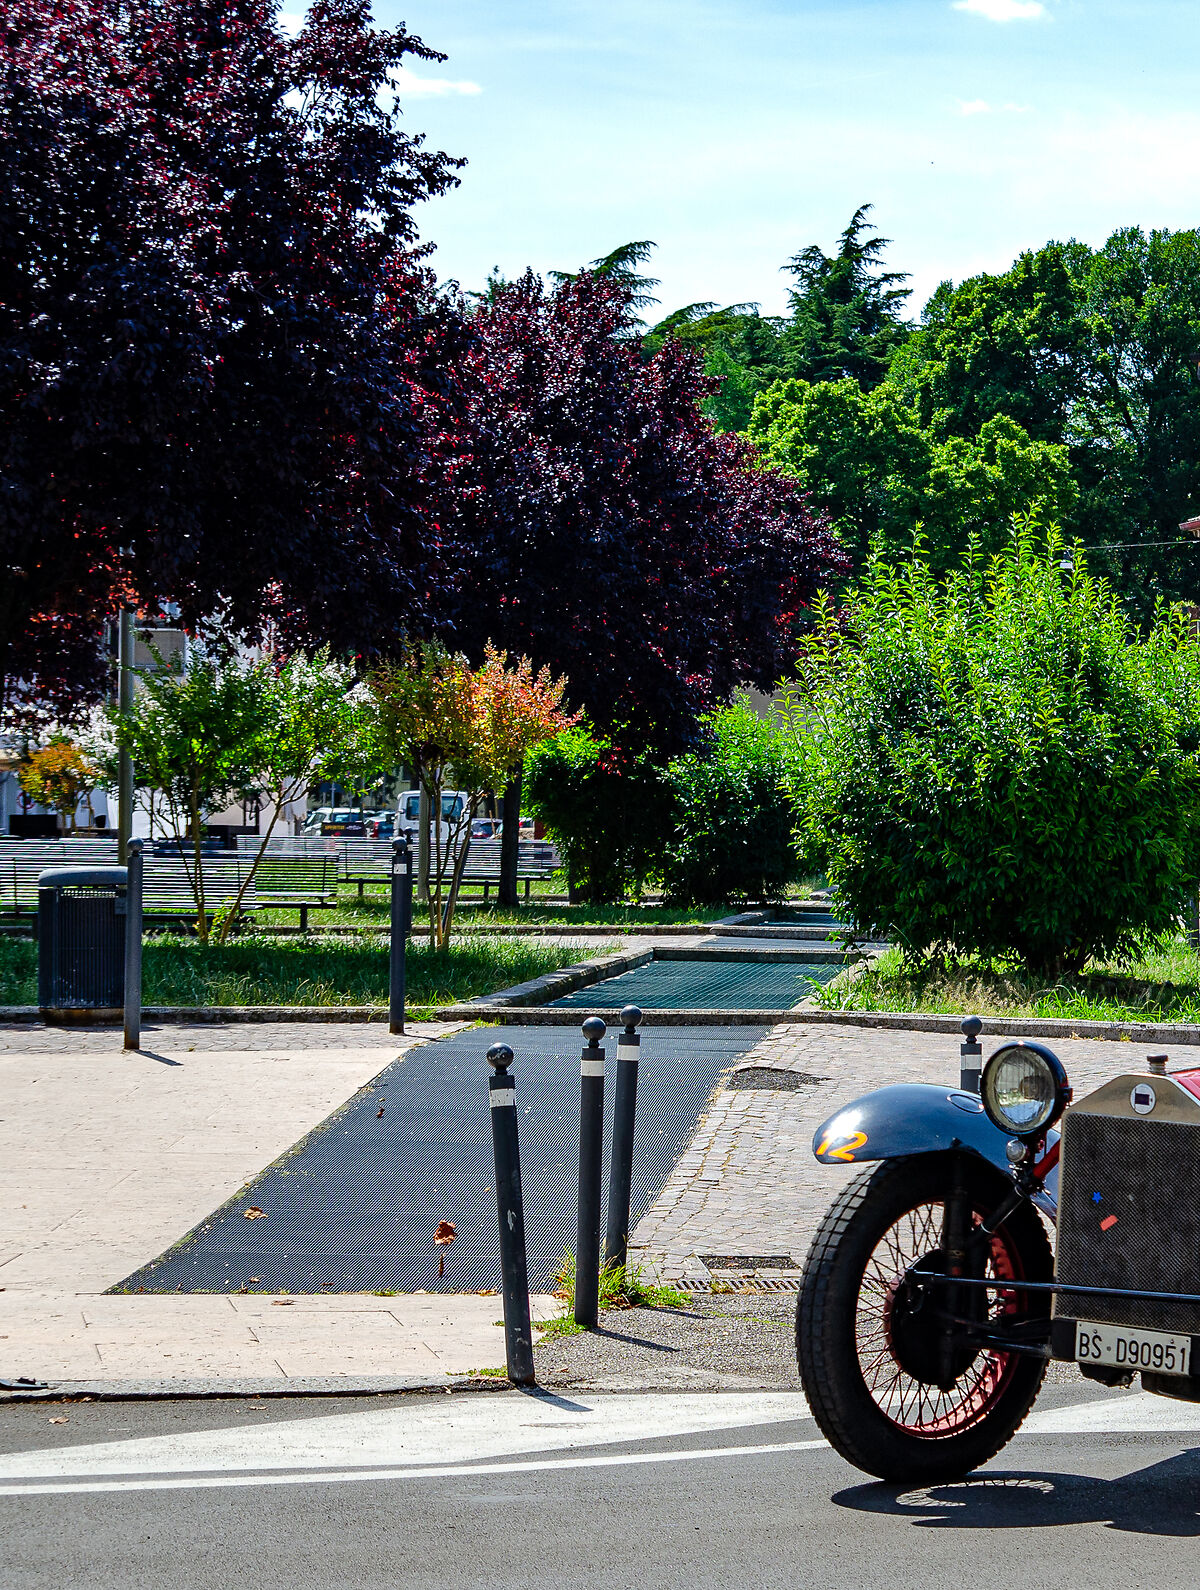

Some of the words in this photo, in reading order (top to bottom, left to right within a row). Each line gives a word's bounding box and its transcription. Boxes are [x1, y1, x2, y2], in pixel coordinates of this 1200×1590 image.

[815, 1129, 869, 1161] 12
[1079, 1332, 1102, 1359] BS
[1116, 1337, 1186, 1372] D90951
